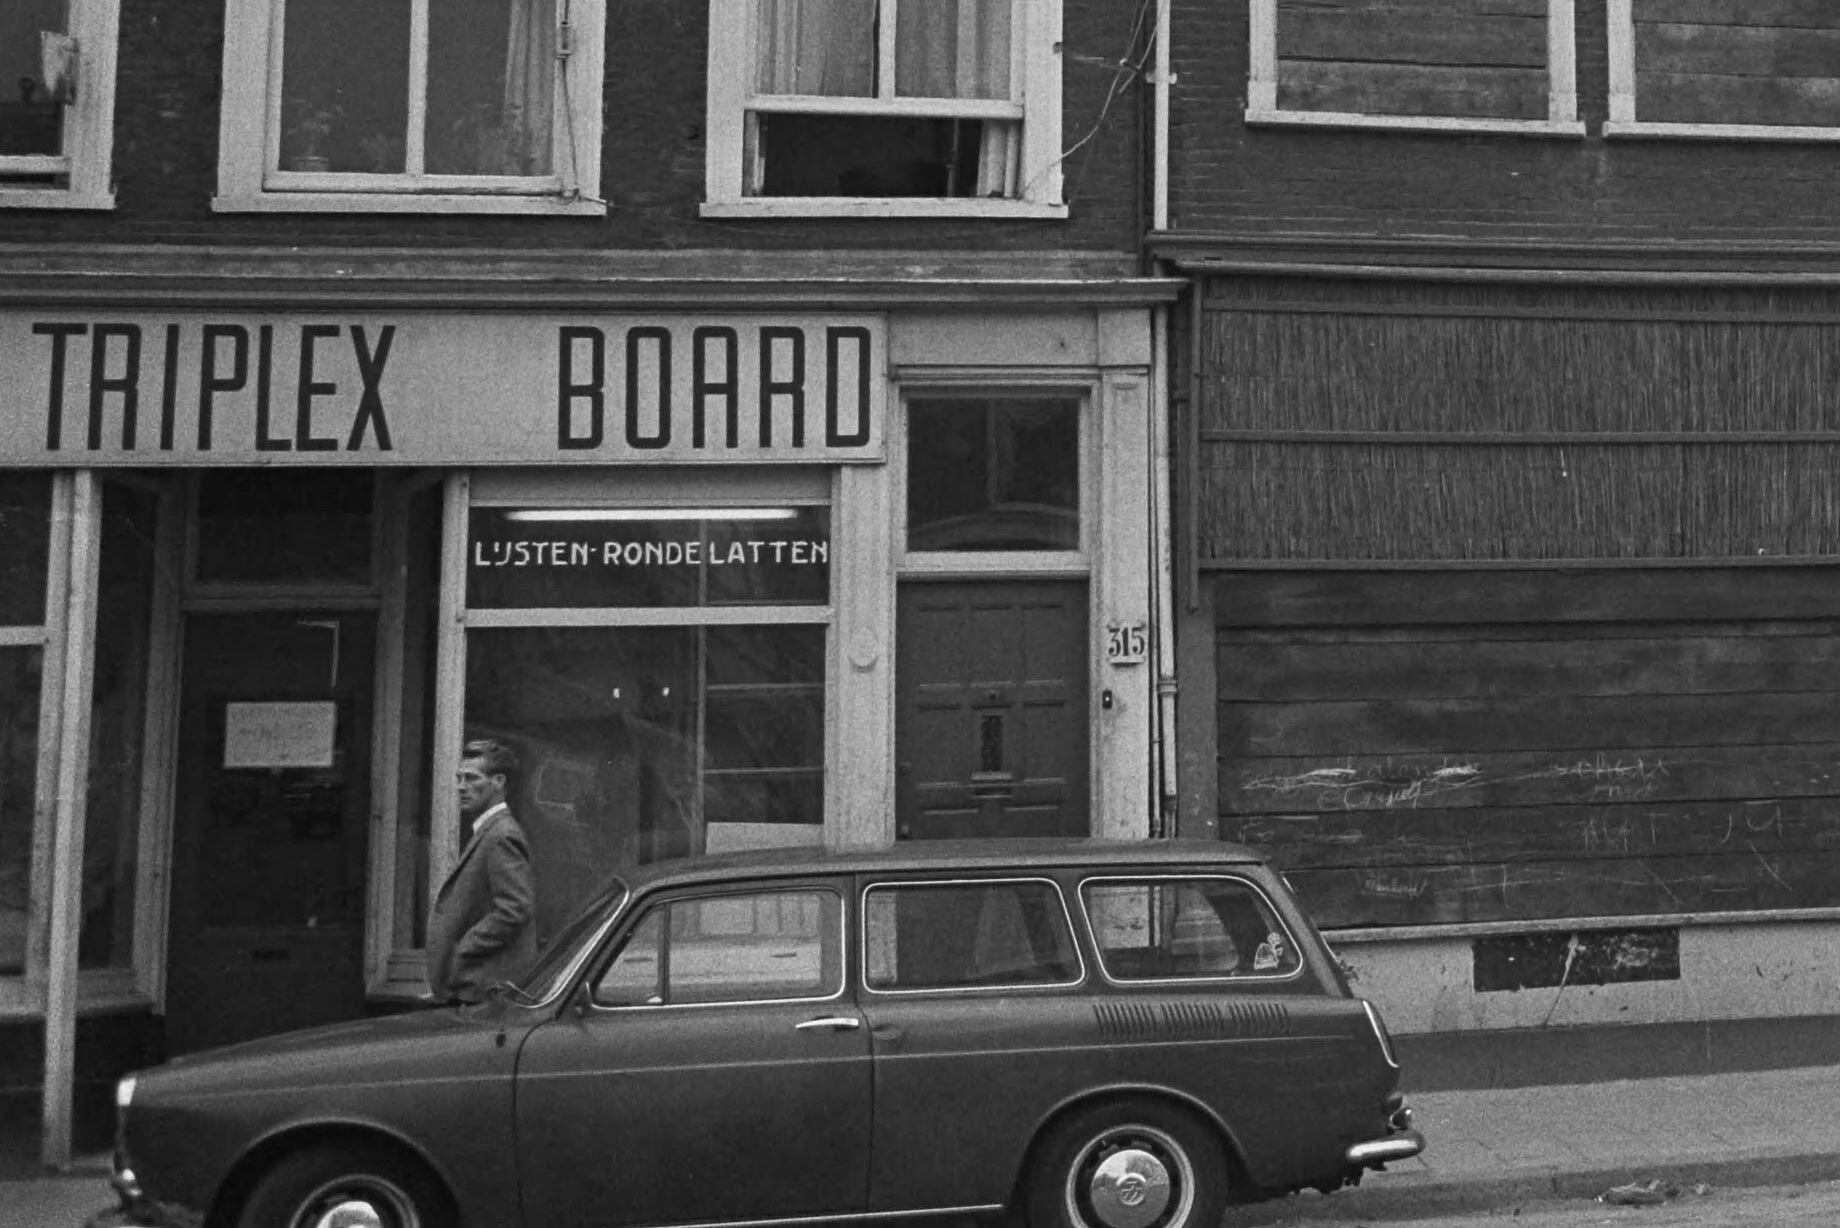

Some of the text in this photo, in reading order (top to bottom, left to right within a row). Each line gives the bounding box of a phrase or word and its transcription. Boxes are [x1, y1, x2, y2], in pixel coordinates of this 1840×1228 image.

[33, 322, 872, 452] TRIPLEX BOARD
[1108, 626, 1146, 657] 315
